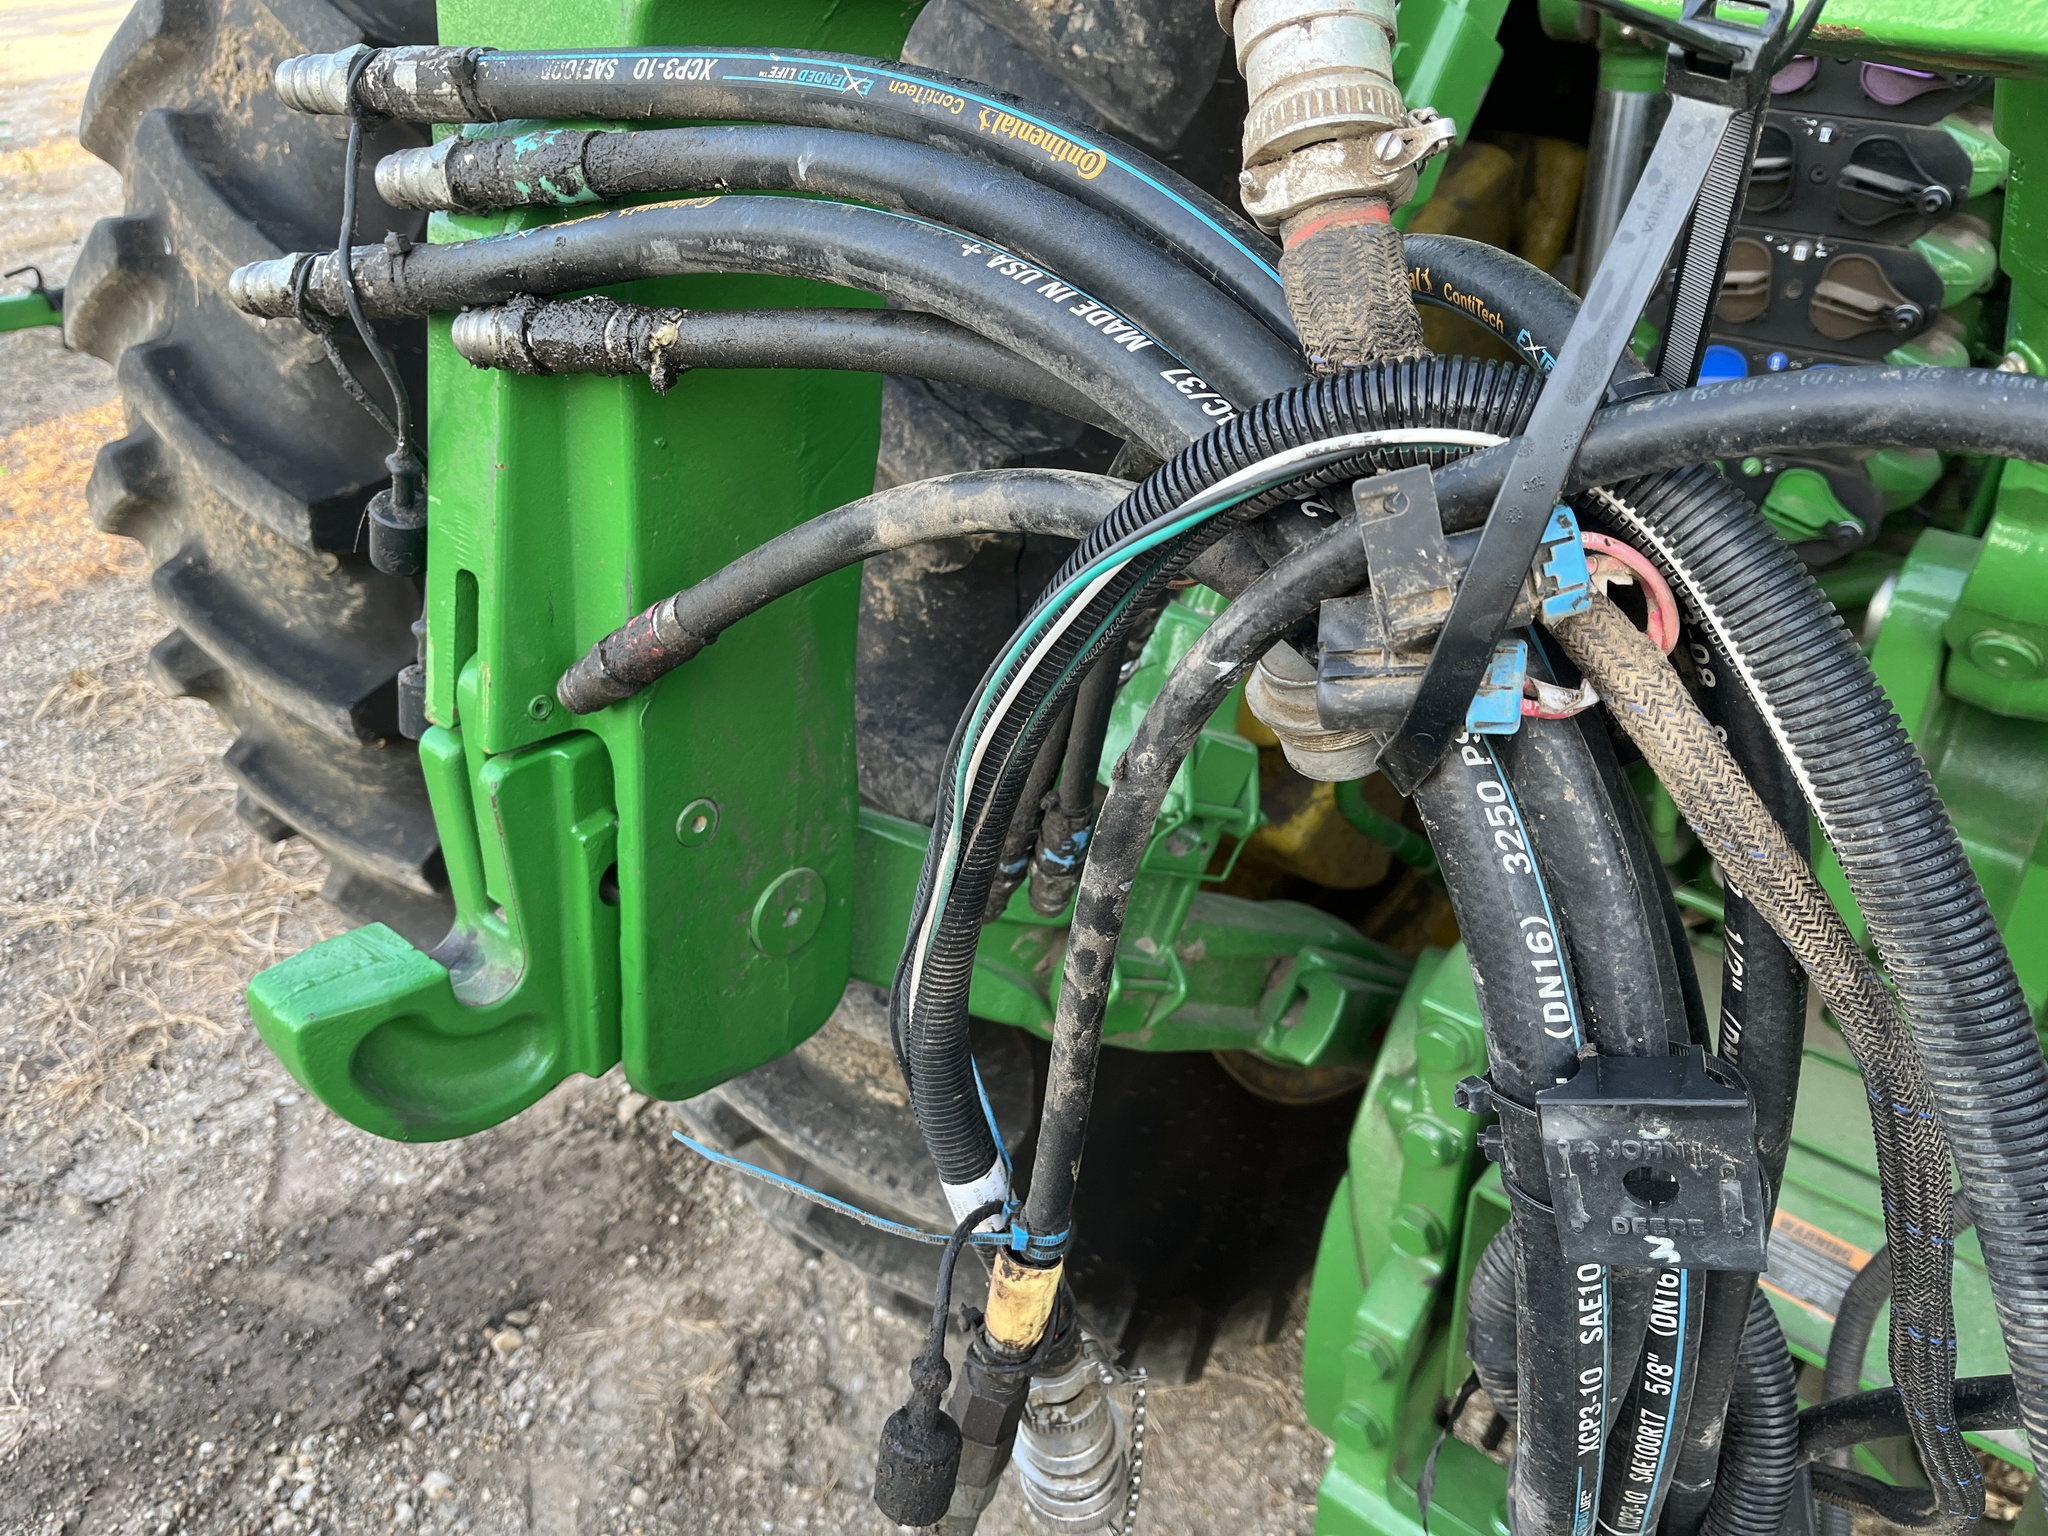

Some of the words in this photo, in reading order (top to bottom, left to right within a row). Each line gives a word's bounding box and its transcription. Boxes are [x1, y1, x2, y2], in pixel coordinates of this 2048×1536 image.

[632, 57, 719, 82] XCP3-10
[797, 65, 875, 100] EXTENDED
[888, 79, 965, 115] ContiTech
[990, 113, 1107, 180] Continental
[985, 254, 1044, 286] USA
[1036, 279, 1079, 305] IN
[1068, 298, 1155, 354] MADE
[1443, 281, 1505, 335] ContiTech
[1475, 779, 1533, 876] 3250
[1519, 915, 1575, 1039] (DN16)
[1605, 1138, 1689, 1162] JOHN
[1611, 1216, 1707, 1238] DEERE
[1643, 1351, 1675, 1396] 5/8"
[1577, 1366, 1604, 1456] XCP3-10
[1628, 1407, 1667, 1485] SAE100R17
[1616, 1489, 1649, 1532] XCP3-10
